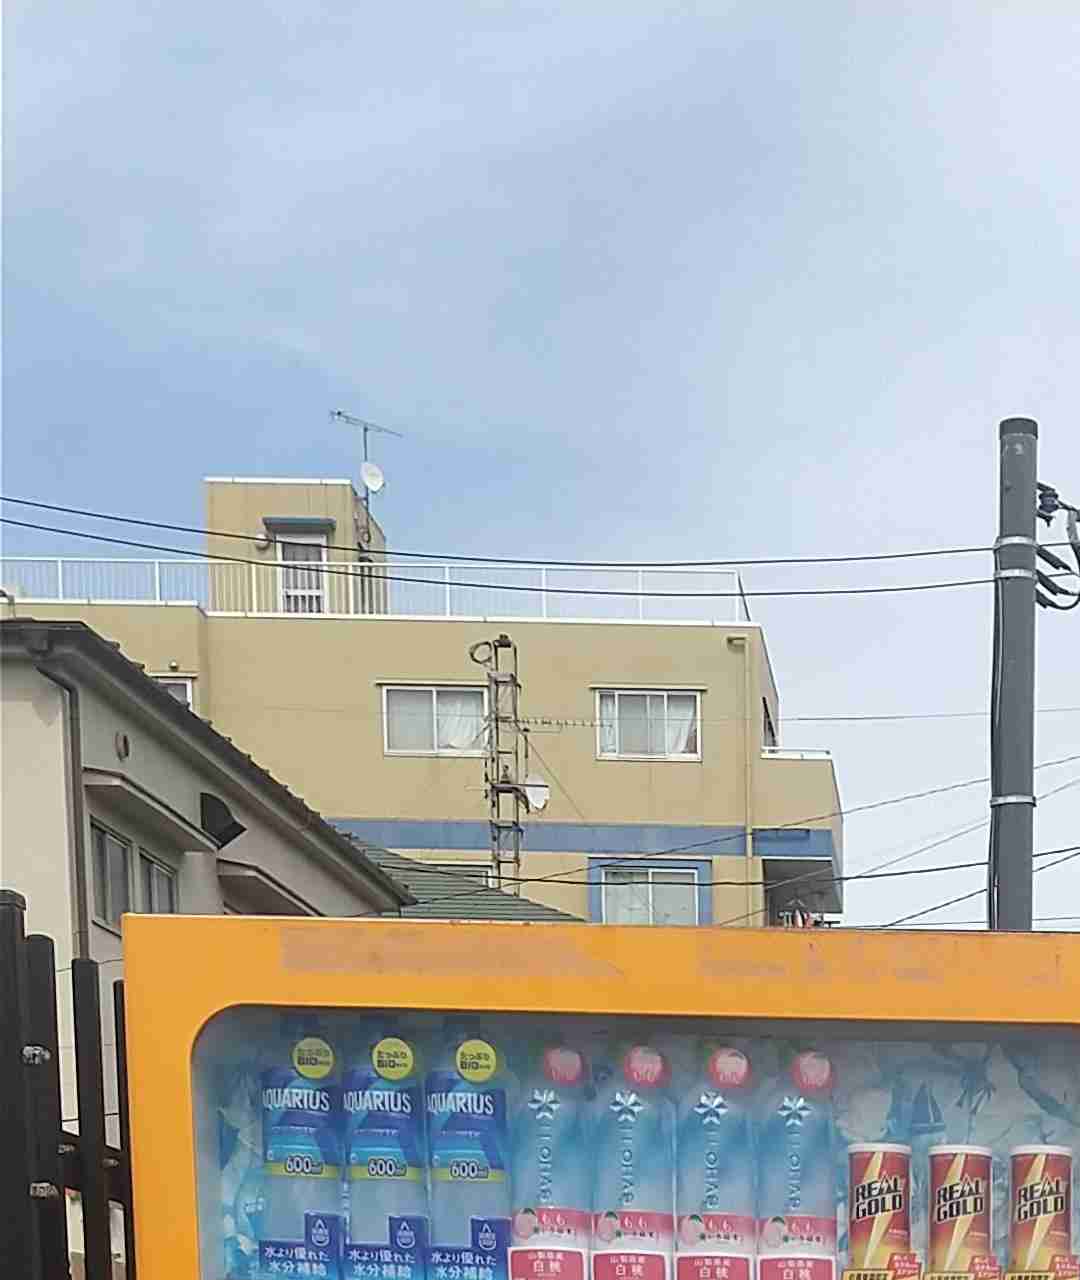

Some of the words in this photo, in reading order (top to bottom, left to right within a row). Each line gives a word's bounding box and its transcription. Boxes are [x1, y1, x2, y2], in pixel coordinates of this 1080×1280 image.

[855, 1172, 904, 1199] REAL
[936, 1175, 986, 1205] REAL
[1016, 1175, 1066, 1204] REAL
[854, 1193, 903, 1221] GOLD
[936, 1196, 984, 1224] GOLD
[1016, 1196, 1065, 1224] GOLD
